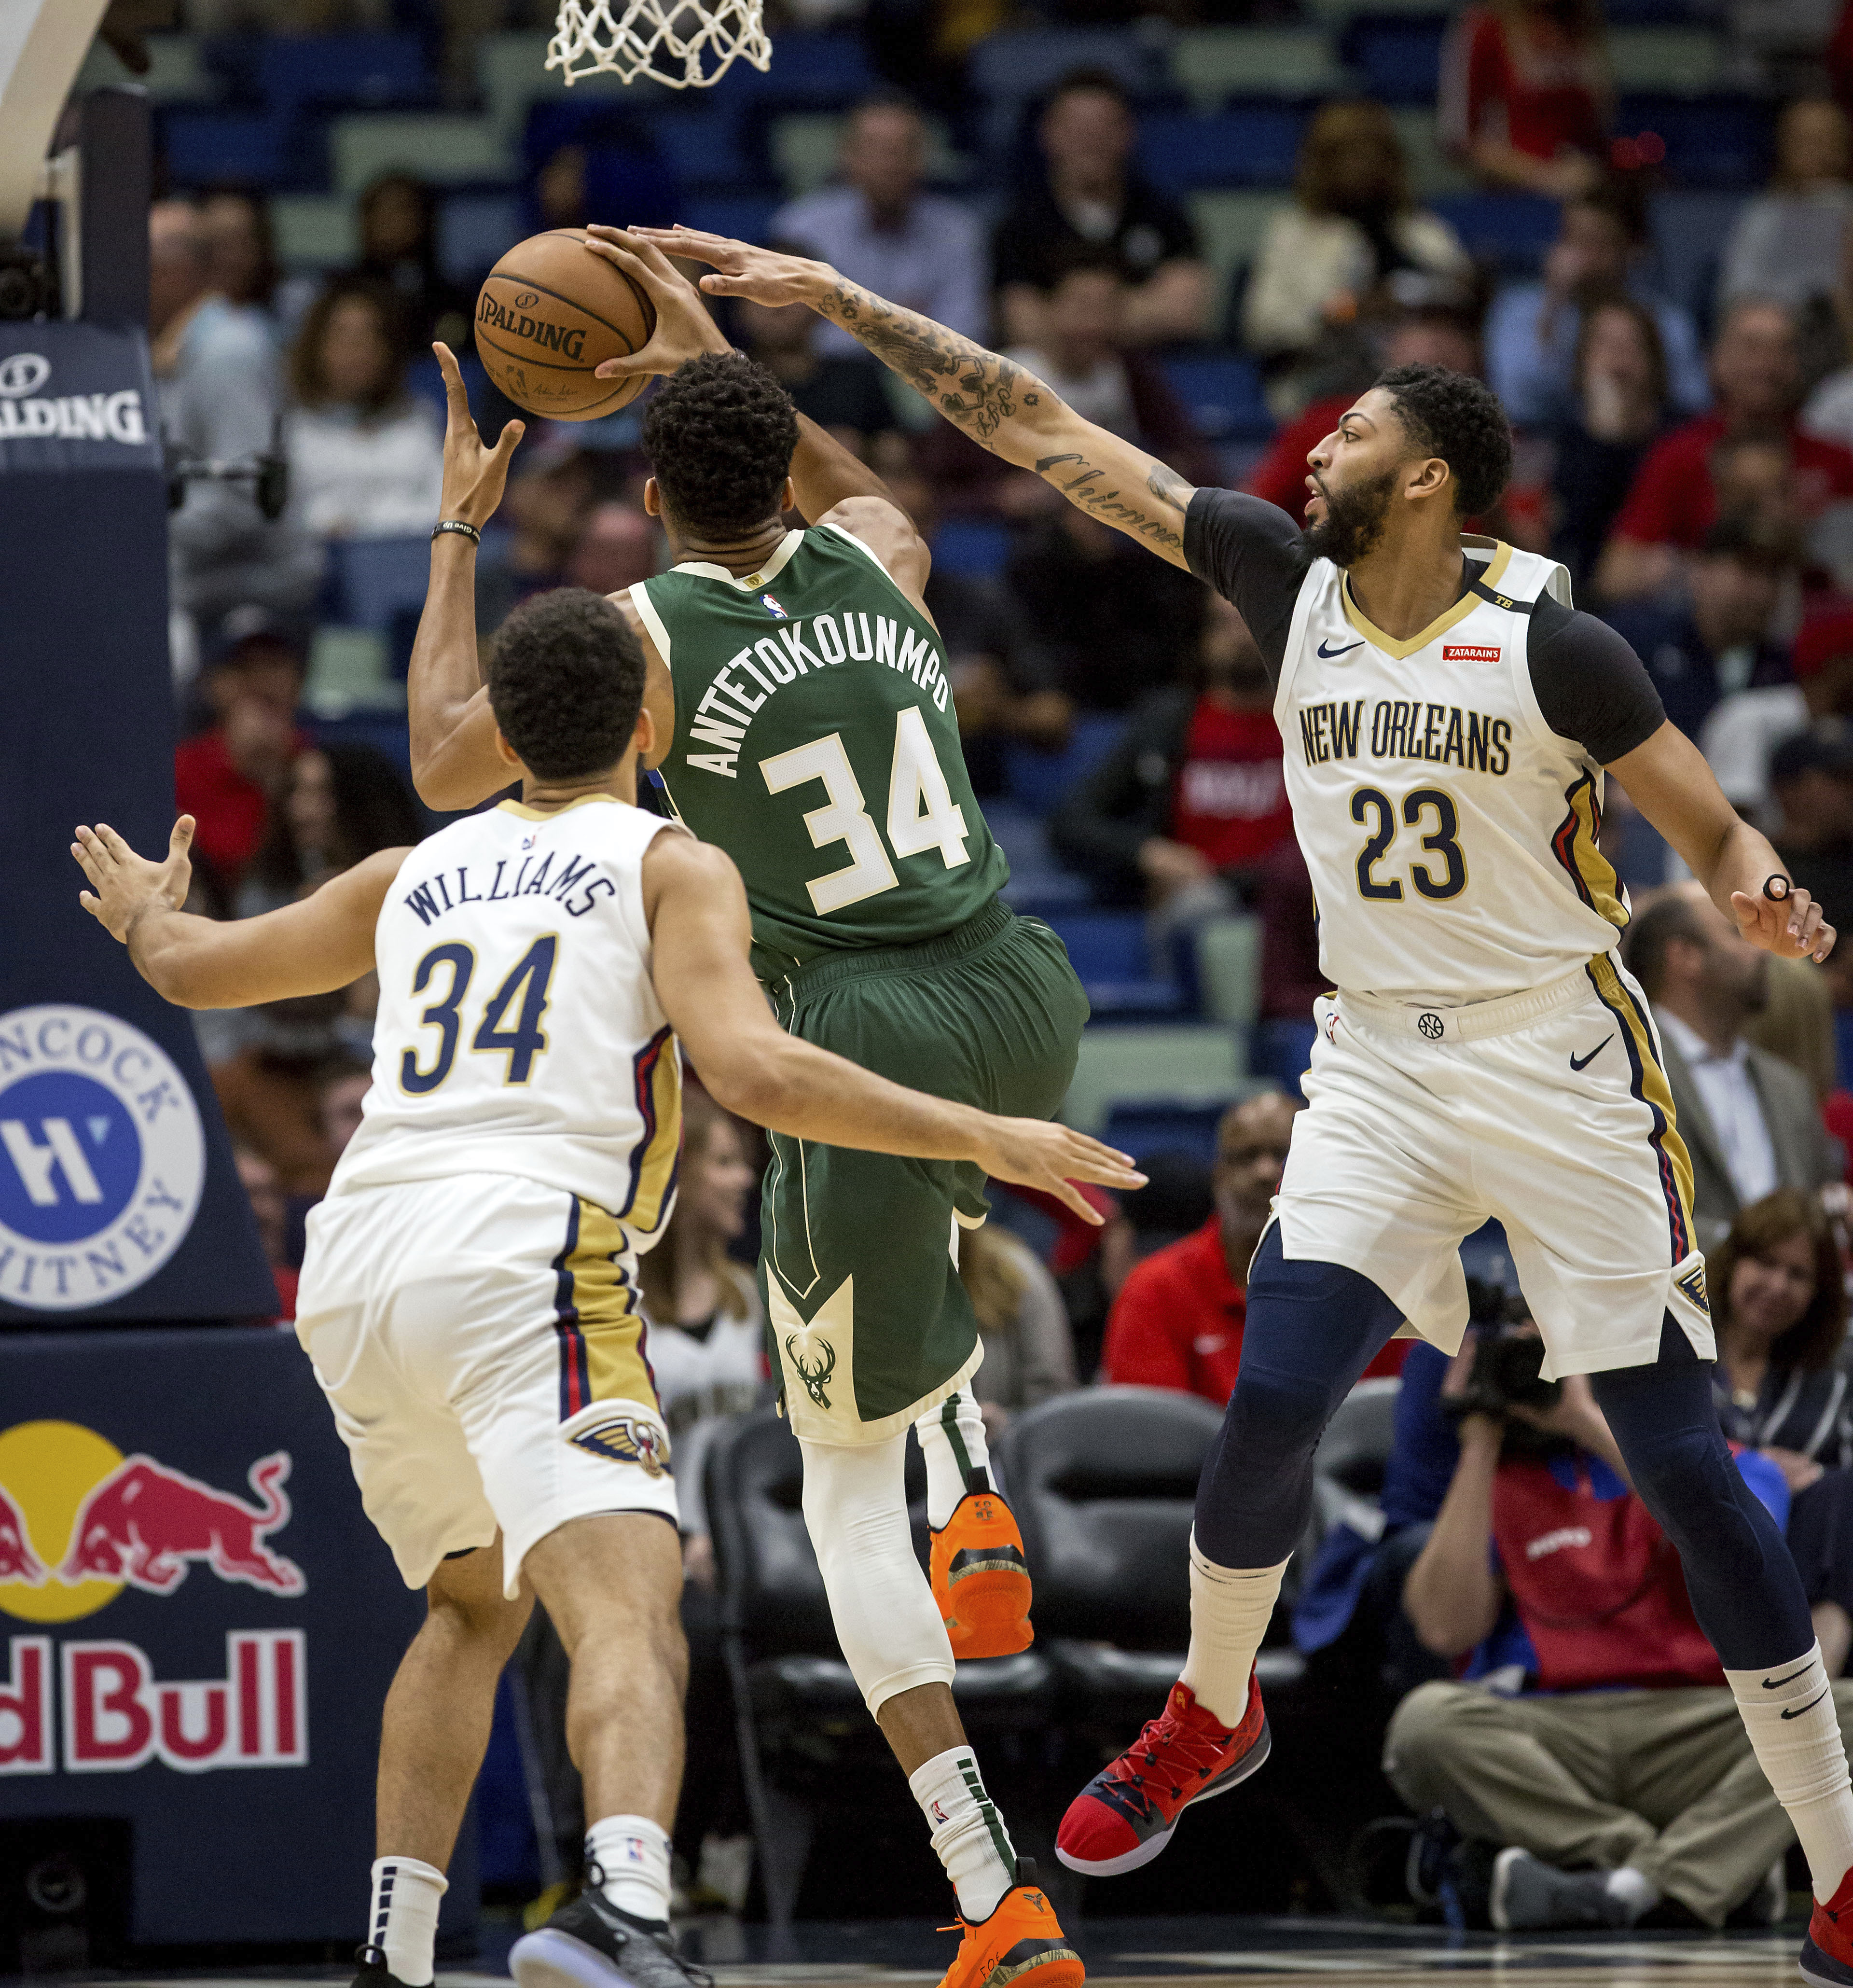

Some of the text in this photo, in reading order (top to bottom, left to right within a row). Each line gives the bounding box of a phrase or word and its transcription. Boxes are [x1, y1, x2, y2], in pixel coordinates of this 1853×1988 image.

[478, 292, 586, 361] SPALDING
[0, 389, 145, 445] LDING
[454, 523, 472, 533] Give
[1495, 595, 1513, 608] TB
[1449, 648, 1498, 658] ZATARAIN'S
[686, 612, 948, 778] ANTETOKOUNMPO
[1299, 699, 1512, 776] NEW ORLEANS
[758, 706, 971, 916] 34
[1349, 785, 1468, 902] 23
[404, 851, 616, 926] WILLIAMS
[398, 931, 560, 1097] 34
[66, 1633, 303, 1768] Bull
